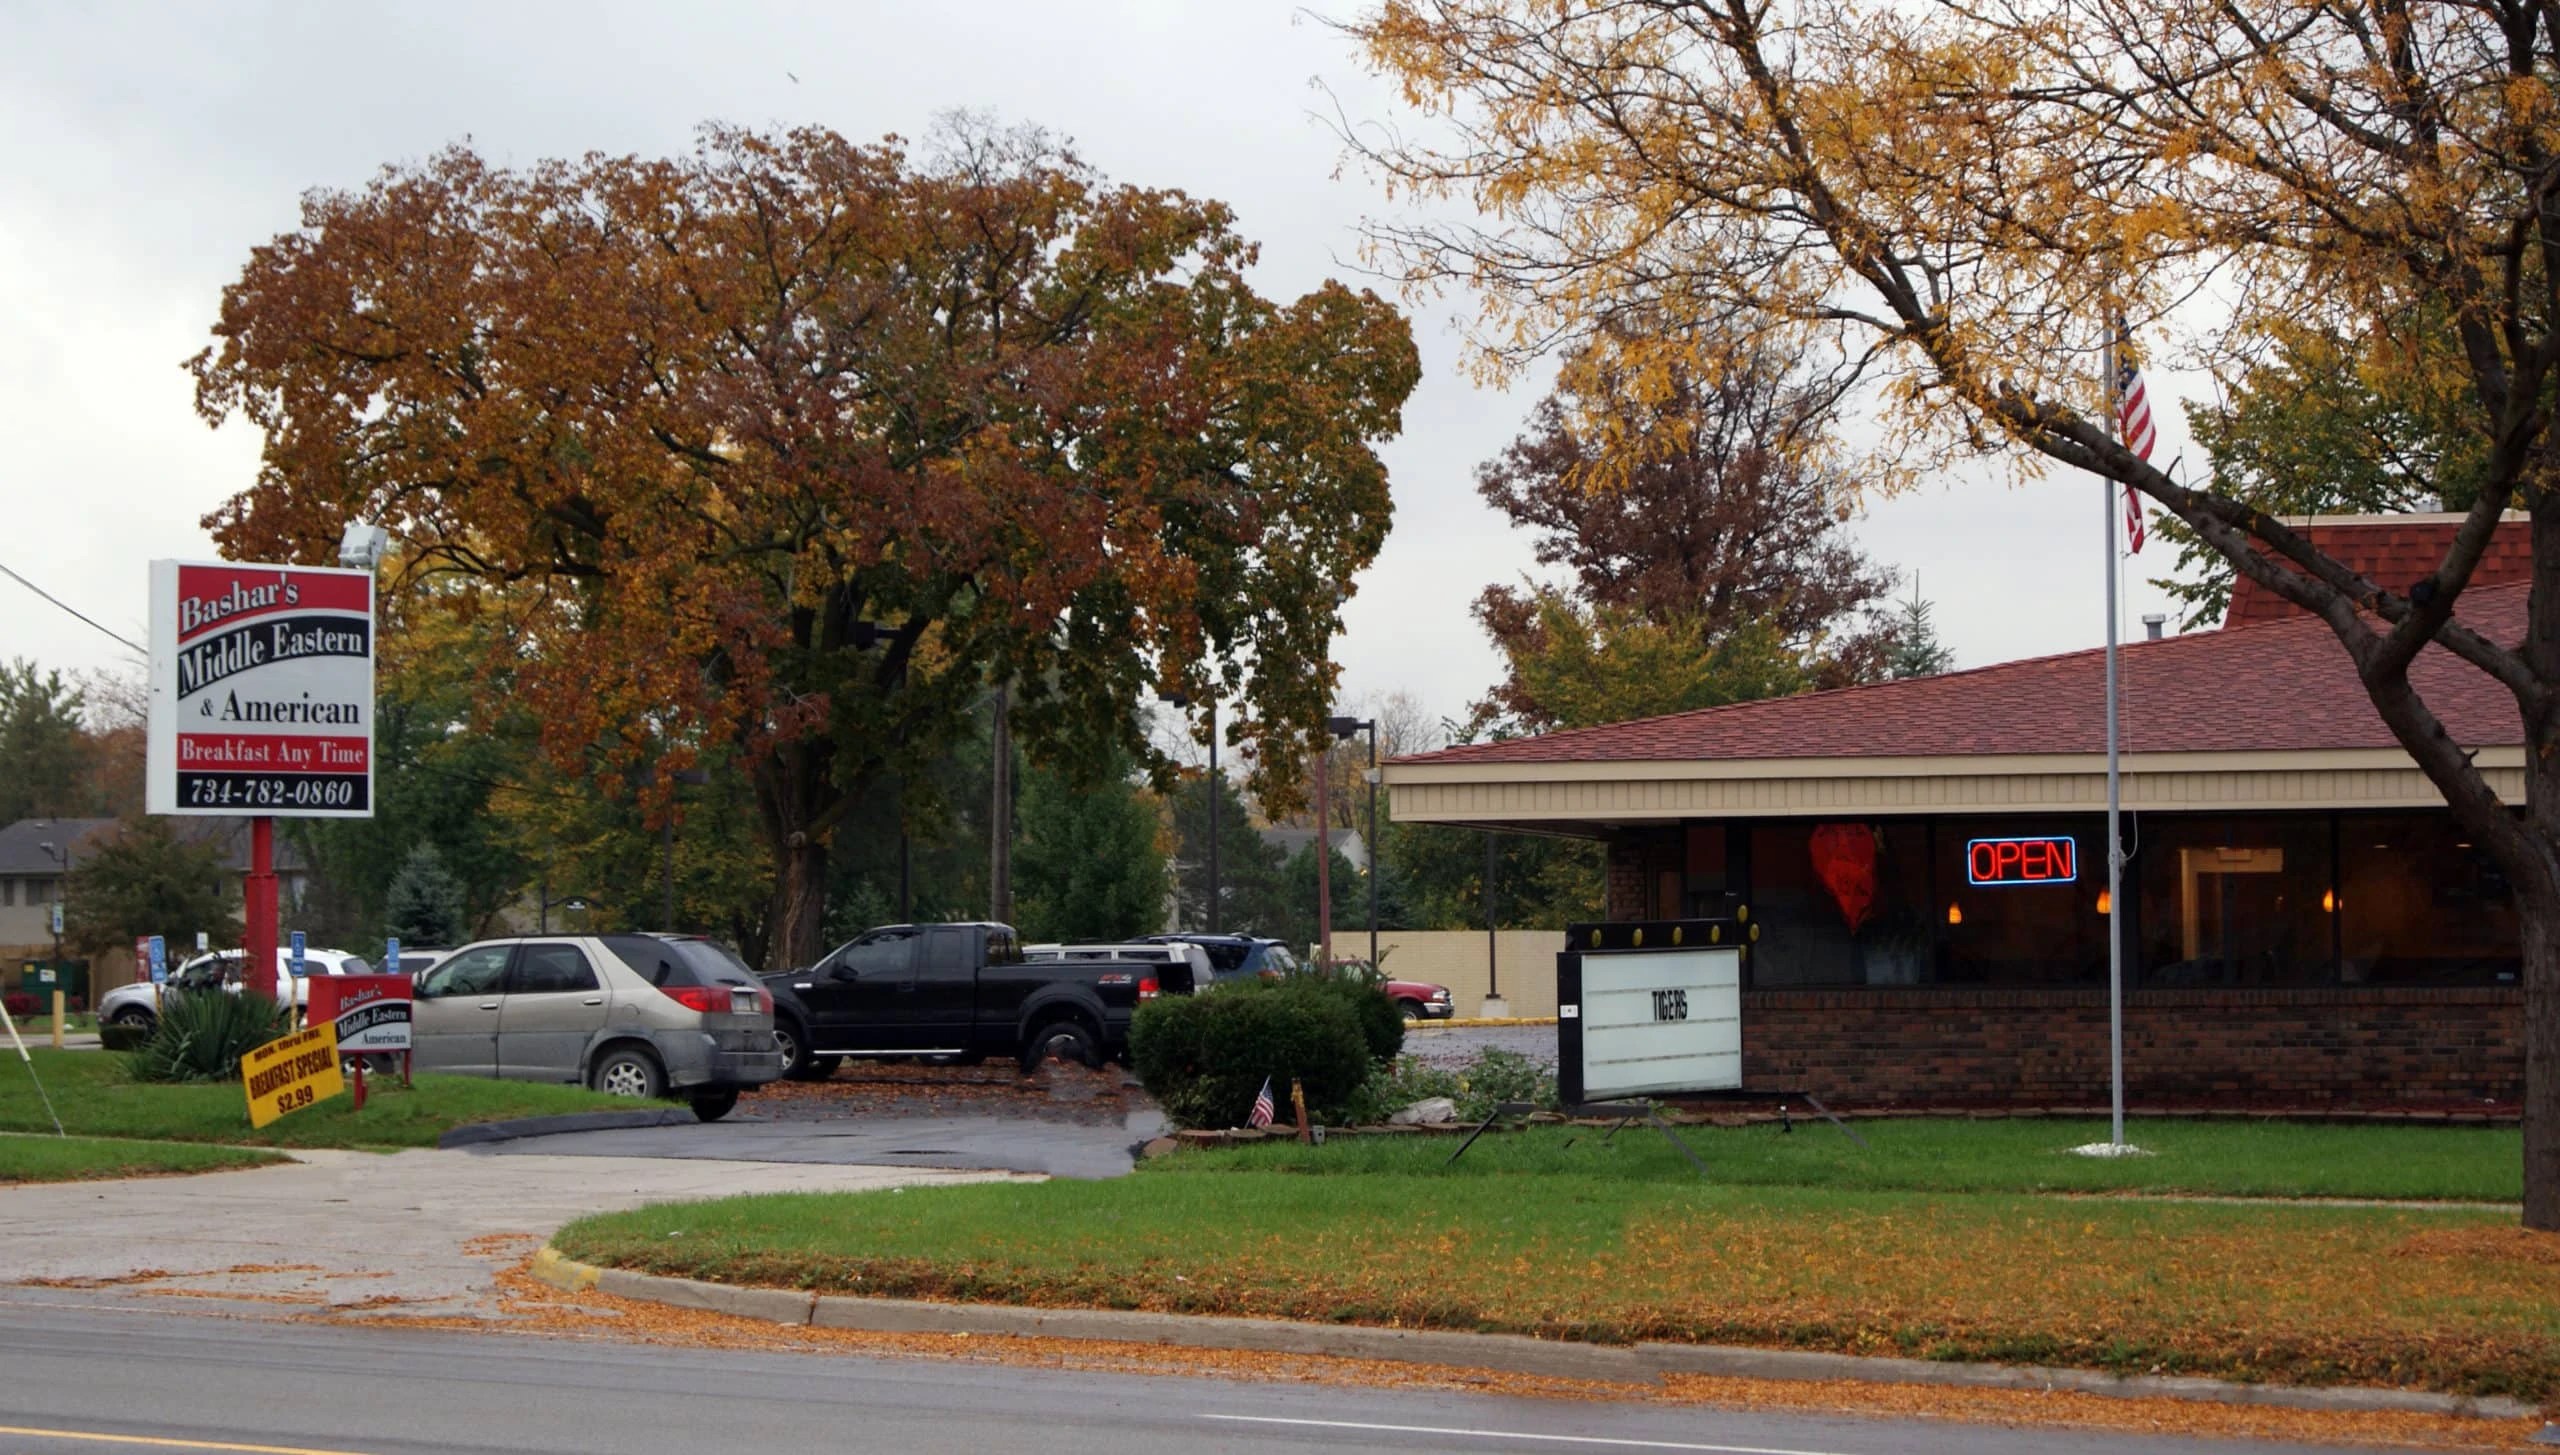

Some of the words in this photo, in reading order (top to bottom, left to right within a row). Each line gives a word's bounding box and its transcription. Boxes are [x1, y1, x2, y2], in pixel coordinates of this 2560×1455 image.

[180, 572, 299, 634] Bashar's
[179, 630, 265, 696] Middle
[272, 622, 363, 659] Eastern
[201, 698, 214, 717] &
[220, 689, 360, 724] American
[182, 738, 270, 762] Breakfast
[277, 740, 312, 769] Any
[319, 741, 364, 764] Time
[191, 778, 353, 805] 734-782-0860
[1971, 841, 2072, 880] OPEN
[340, 984, 383, 1011] Bashar's
[1652, 989, 1688, 1022] TIGERS
[338, 1012, 371, 1038] Middle
[372, 1007, 407, 1023] Eastern
[362, 1031, 406, 1044] American
[249, 1059, 296, 1100] BREAKFAST
[295, 1046, 333, 1079] SPECIAL
[277, 1085, 314, 1114] $2.99
